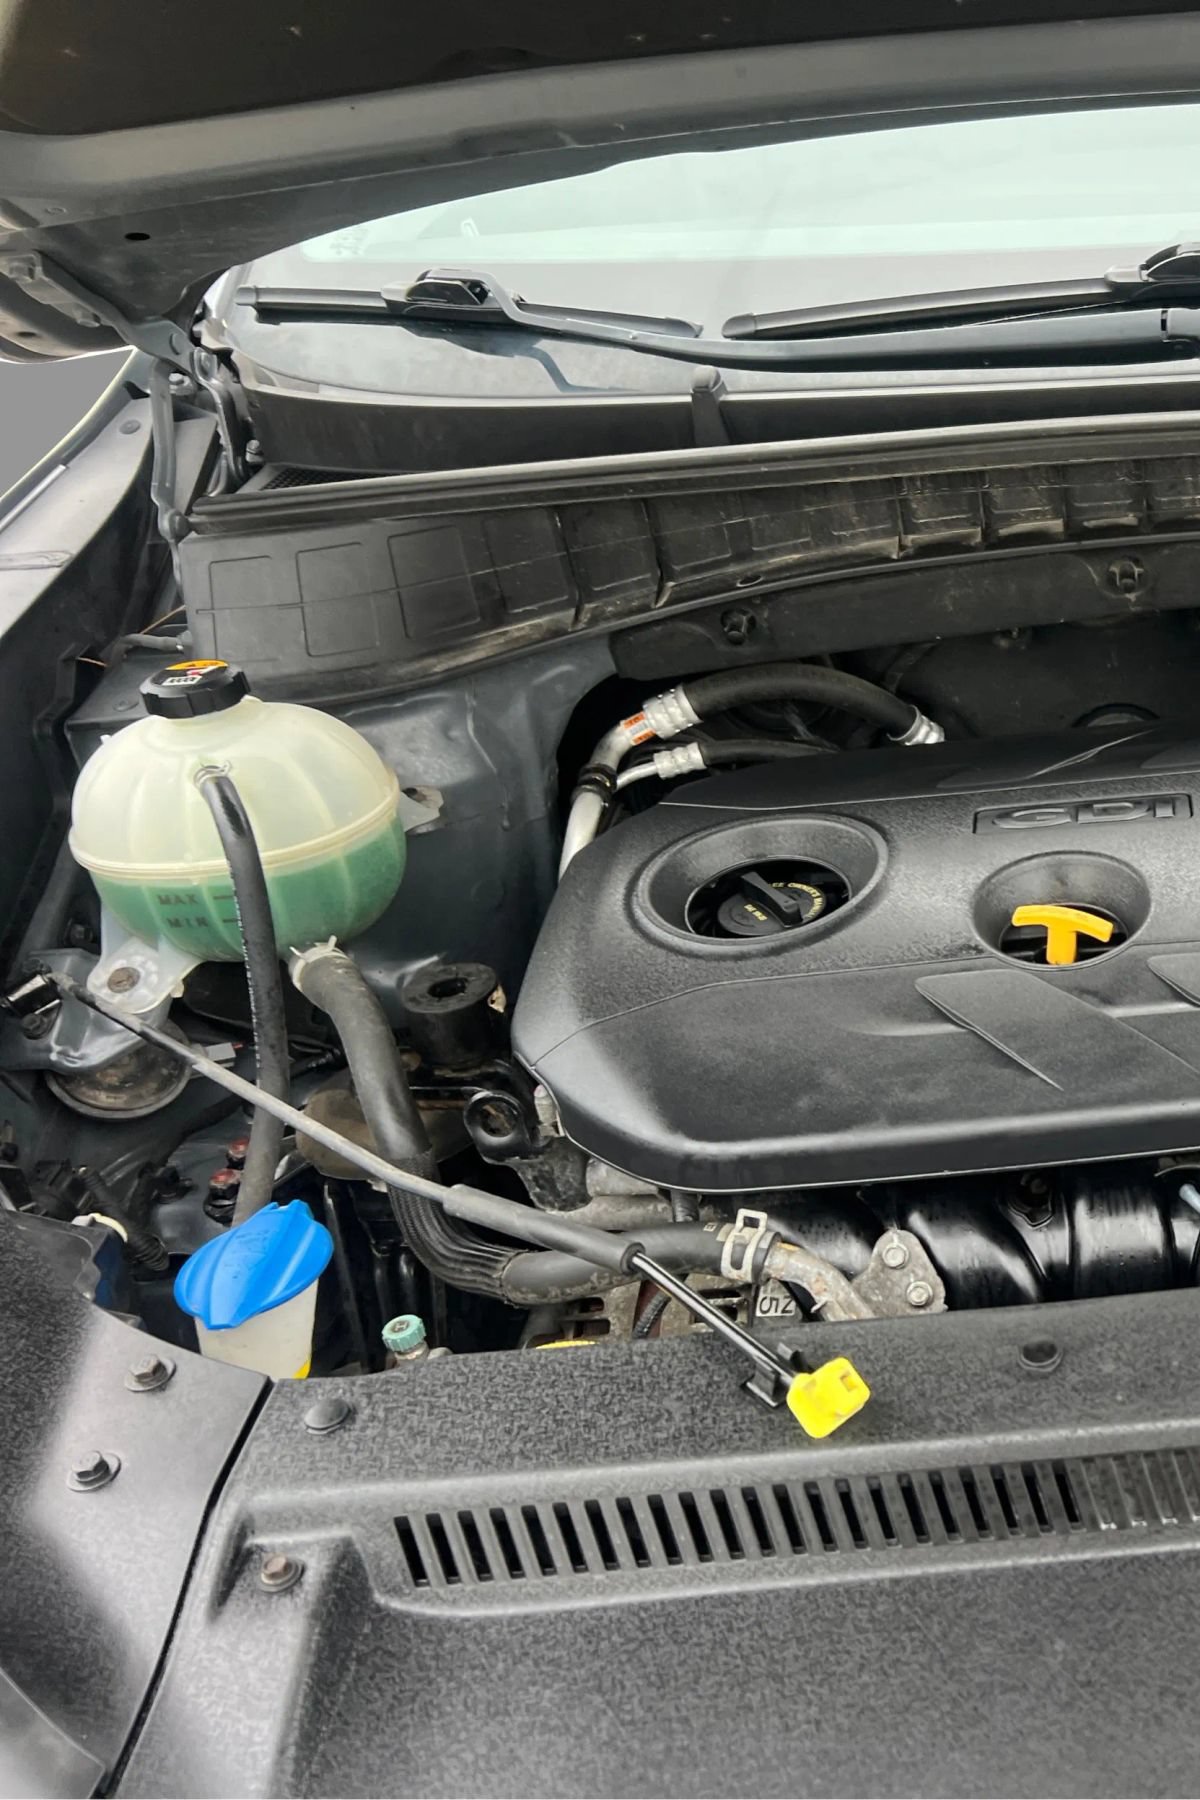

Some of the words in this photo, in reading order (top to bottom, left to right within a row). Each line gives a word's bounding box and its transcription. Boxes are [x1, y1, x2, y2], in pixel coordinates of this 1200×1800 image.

[991, 800, 1176, 829] GDI
[158, 894, 198, 905] MAX
[166, 917, 208, 928] MIN
